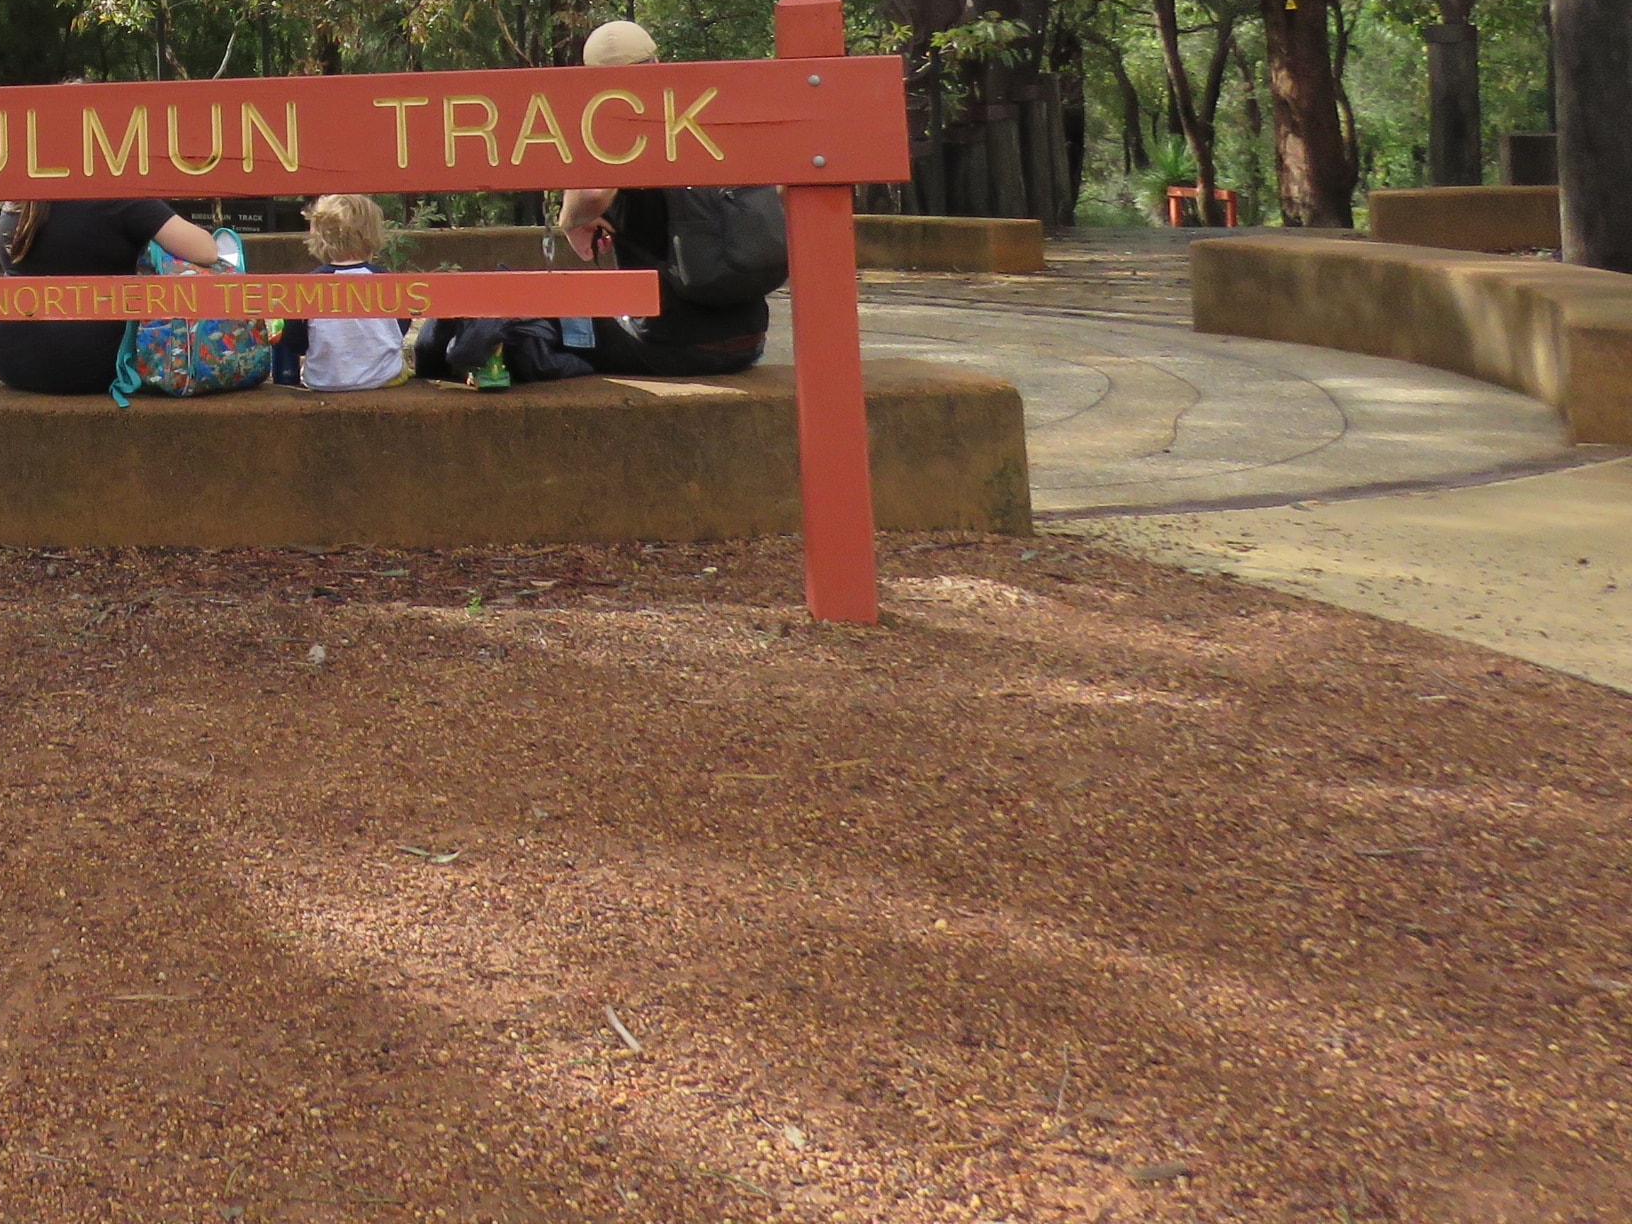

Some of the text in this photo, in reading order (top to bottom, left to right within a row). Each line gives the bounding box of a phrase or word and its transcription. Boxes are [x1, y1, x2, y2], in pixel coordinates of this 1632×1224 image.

[372, 86, 725, 169] TRACK
[237, 214, 263, 222] TRACK
[214, 280, 433, 316] TERMINUS
